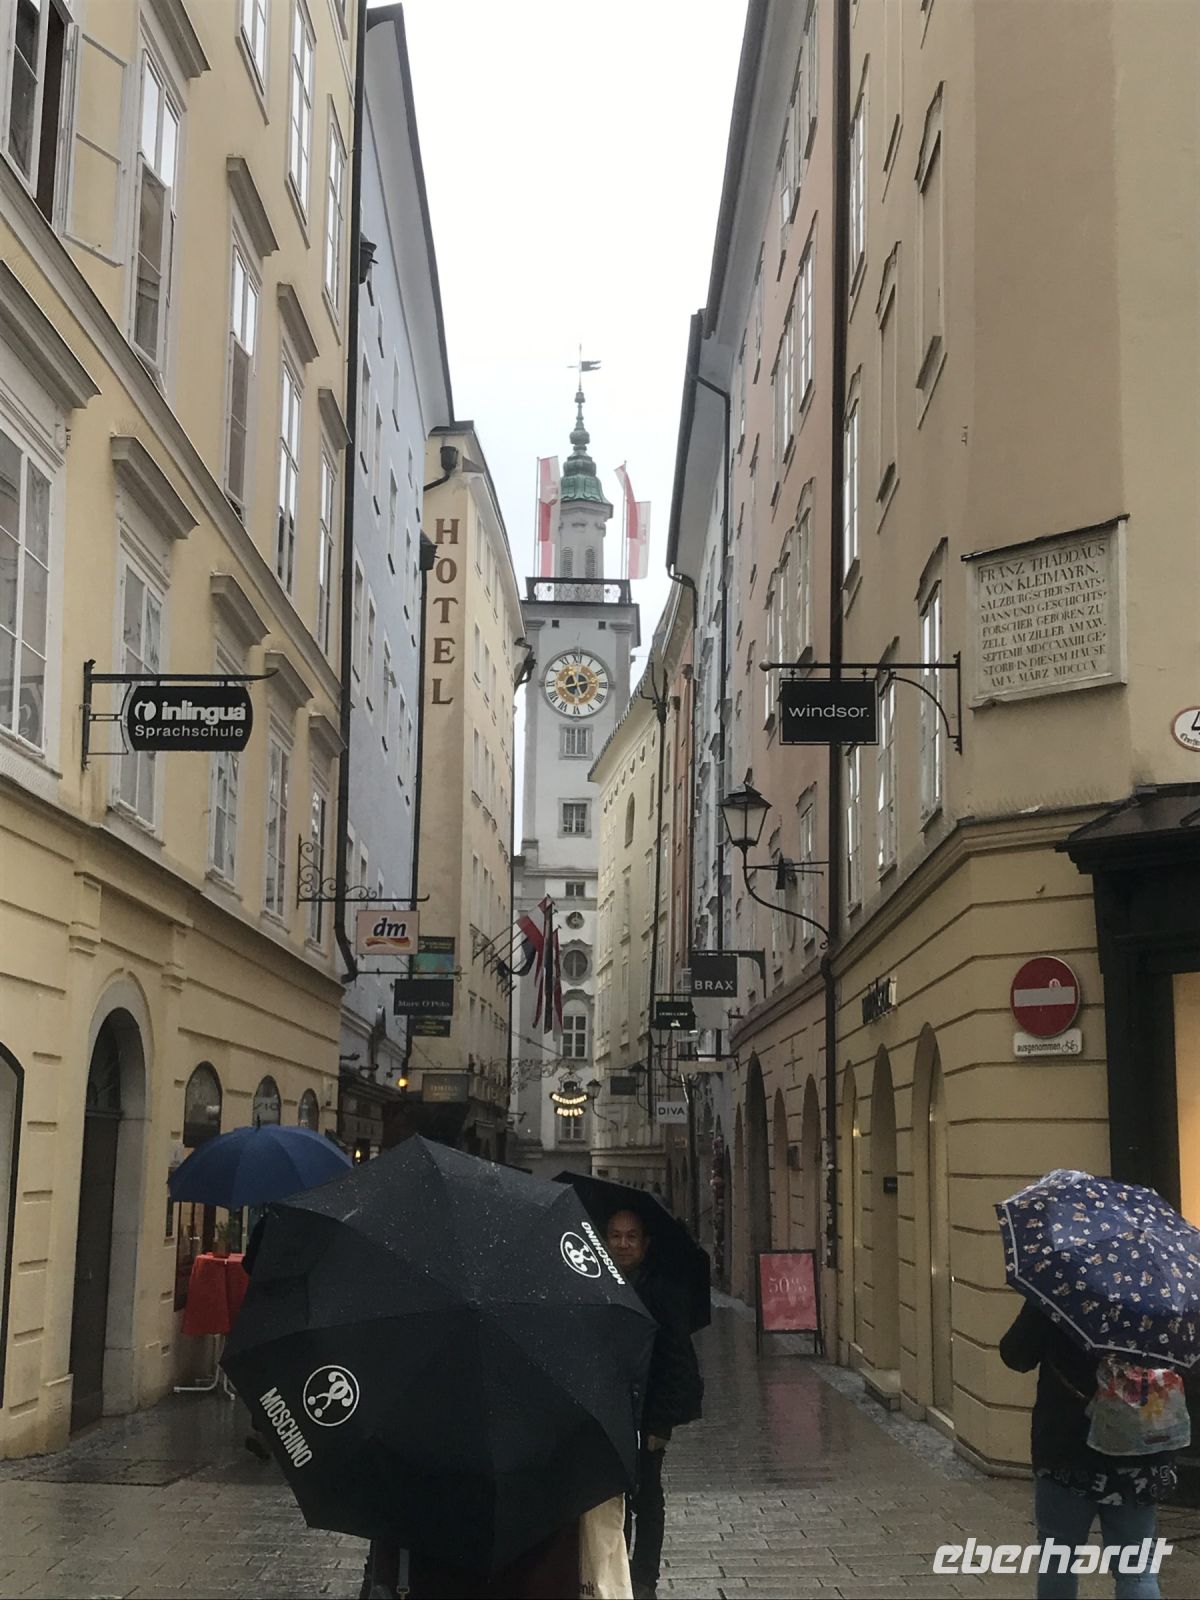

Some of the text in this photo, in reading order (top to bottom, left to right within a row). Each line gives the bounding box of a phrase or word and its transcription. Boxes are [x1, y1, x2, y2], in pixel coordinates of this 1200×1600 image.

[980, 562, 1025, 583] FRANZ
[986, 581, 1014, 595] VON
[431, 518, 460, 705] HOTEL
[981, 610, 1011, 623] MANN
[1014, 604, 1035, 617] UND
[982, 604, 1103, 637] FORSCHER GEBOREN ZU
[982, 637, 1007, 650] ZELL
[1012, 632, 1026, 644] AM
[1028, 625, 1064, 641] ZILLER
[1069, 621, 1084, 632] AM
[983, 644, 1106, 675] STORB IN DIESEM HAUSE
[1019, 667, 1049, 682] MÄRZ
[134, 724, 244, 739] Sprachschule
[372, 917, 407, 937] dm
[694, 980, 734, 991] BRAX
[1017, 1042, 1061, 1054] ausgenommen
[556, 1107, 584, 1117] HOTEL
[658, 1105, 685, 1116] DIVA
[581, 1221, 626, 1285] MOSCHINO
[259, 1386, 313, 1468] MOSCHINO
